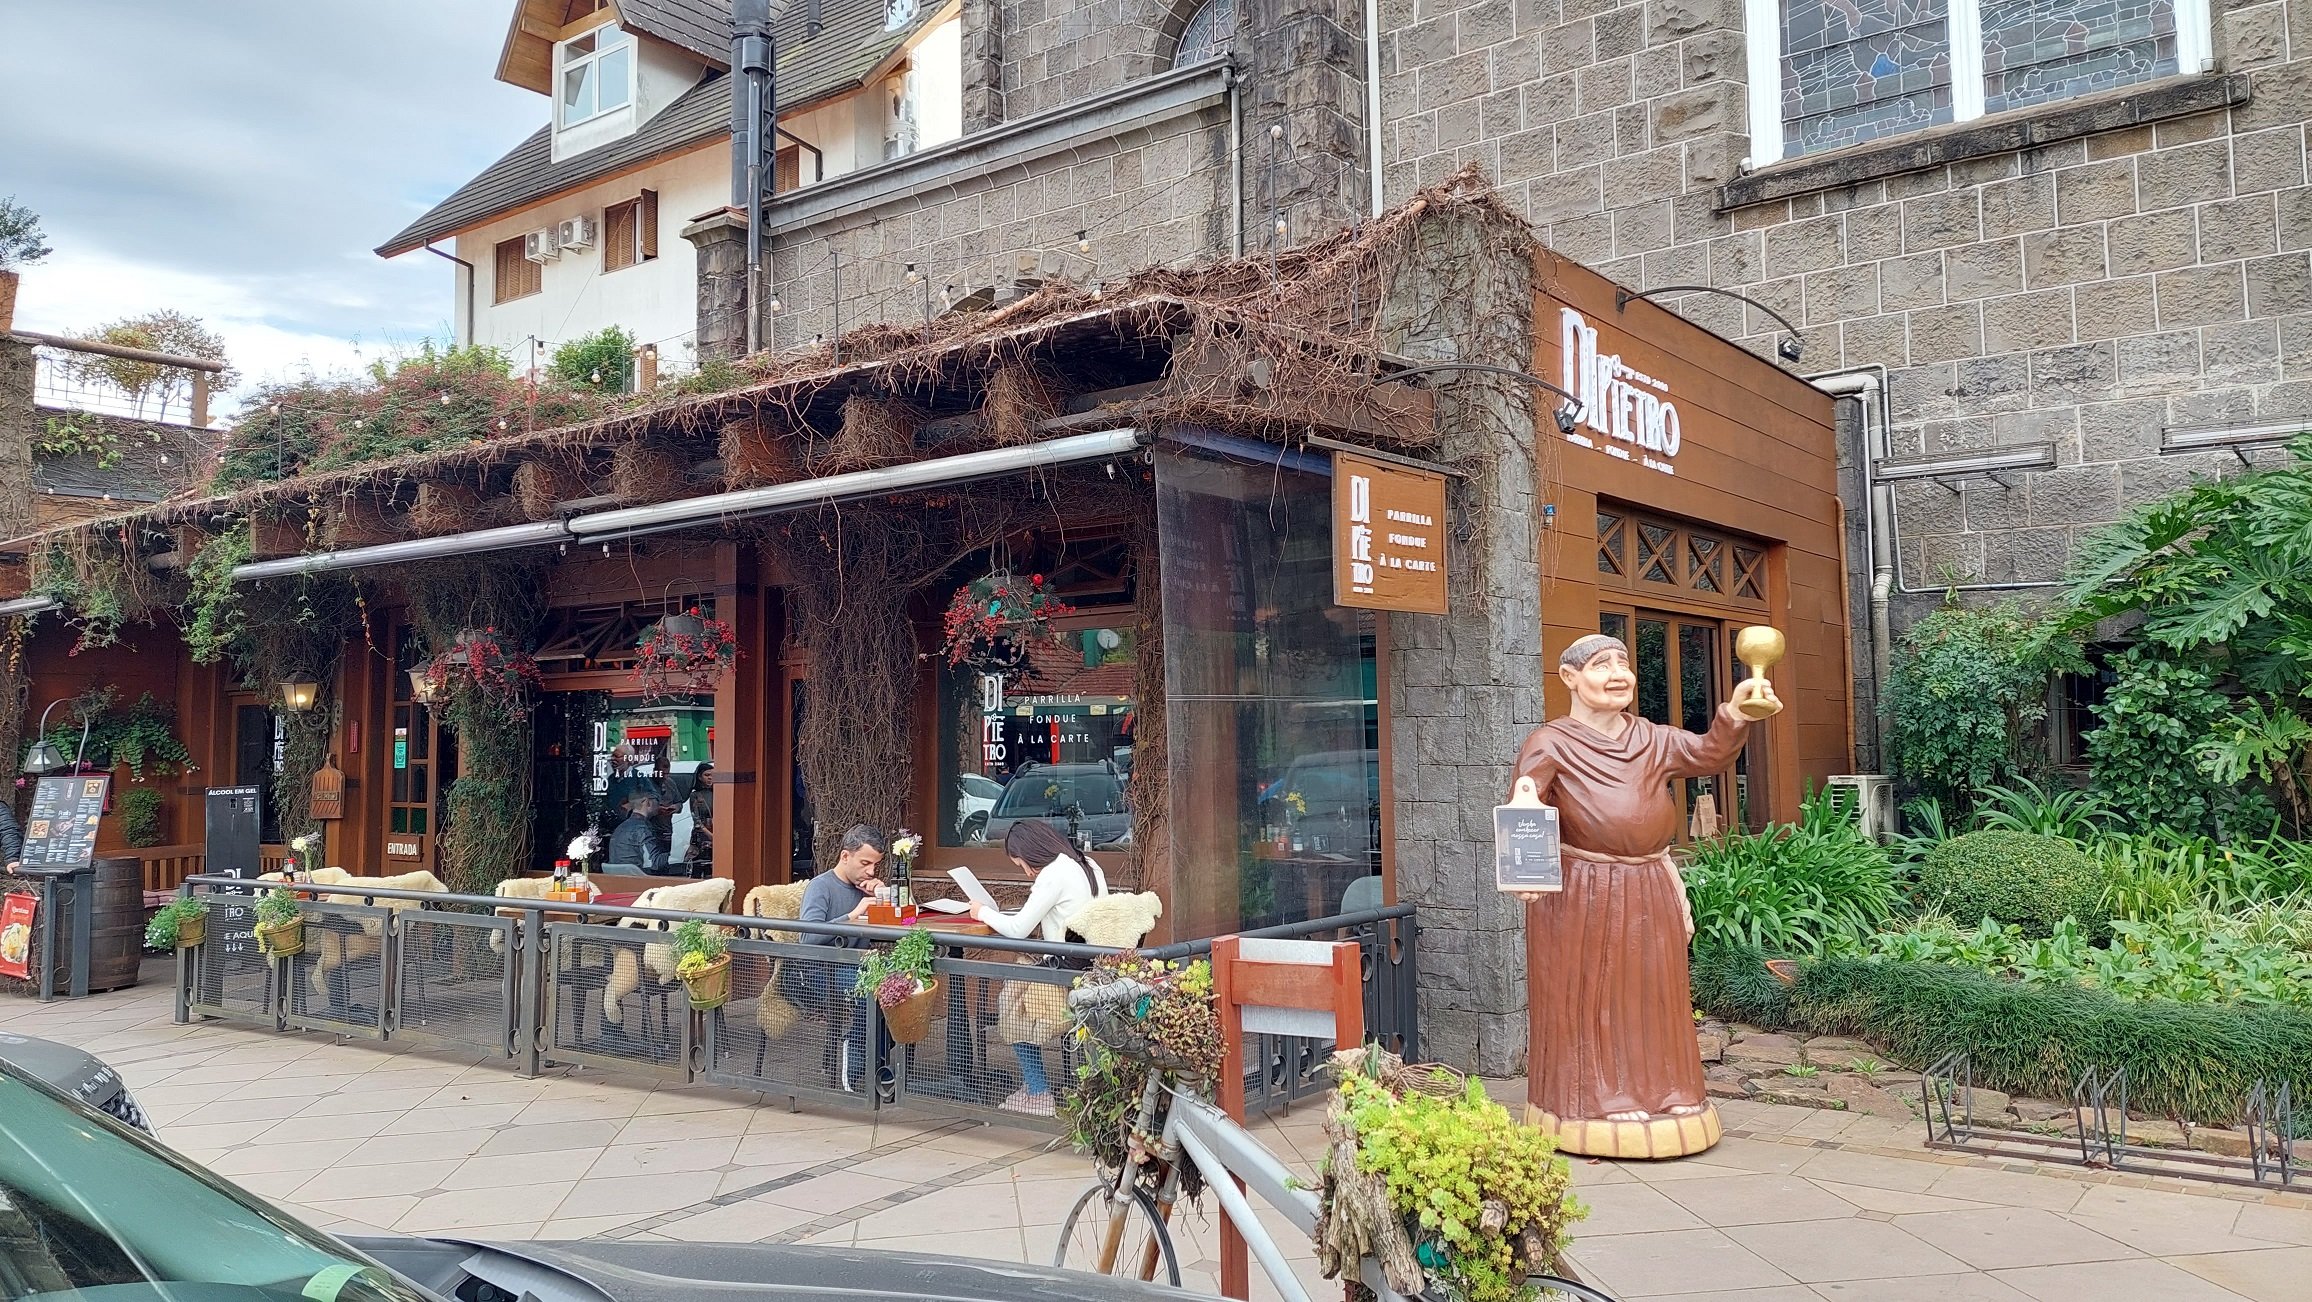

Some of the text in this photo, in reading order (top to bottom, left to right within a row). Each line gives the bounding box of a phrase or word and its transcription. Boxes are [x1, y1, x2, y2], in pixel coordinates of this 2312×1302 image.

[1351, 475, 1370, 524] DI
[1387, 509, 1433, 526] PARRILLA
[1388, 533, 1427, 548] FONDUE
[1390, 557, 1402, 569] LA
[1405, 559, 1437, 572] CARTE
[983, 674, 1003, 712] DI
[1024, 694, 1081, 704] PARRILLA
[1029, 713, 1077, 724] FONDUE
[593, 722, 607, 751] DI
[1017, 733, 1089, 745] À LA CARTE
[983, 743, 1006, 760] TRO
[593, 777, 608, 791] TRO
[387, 842, 417, 856] ENTRADA
